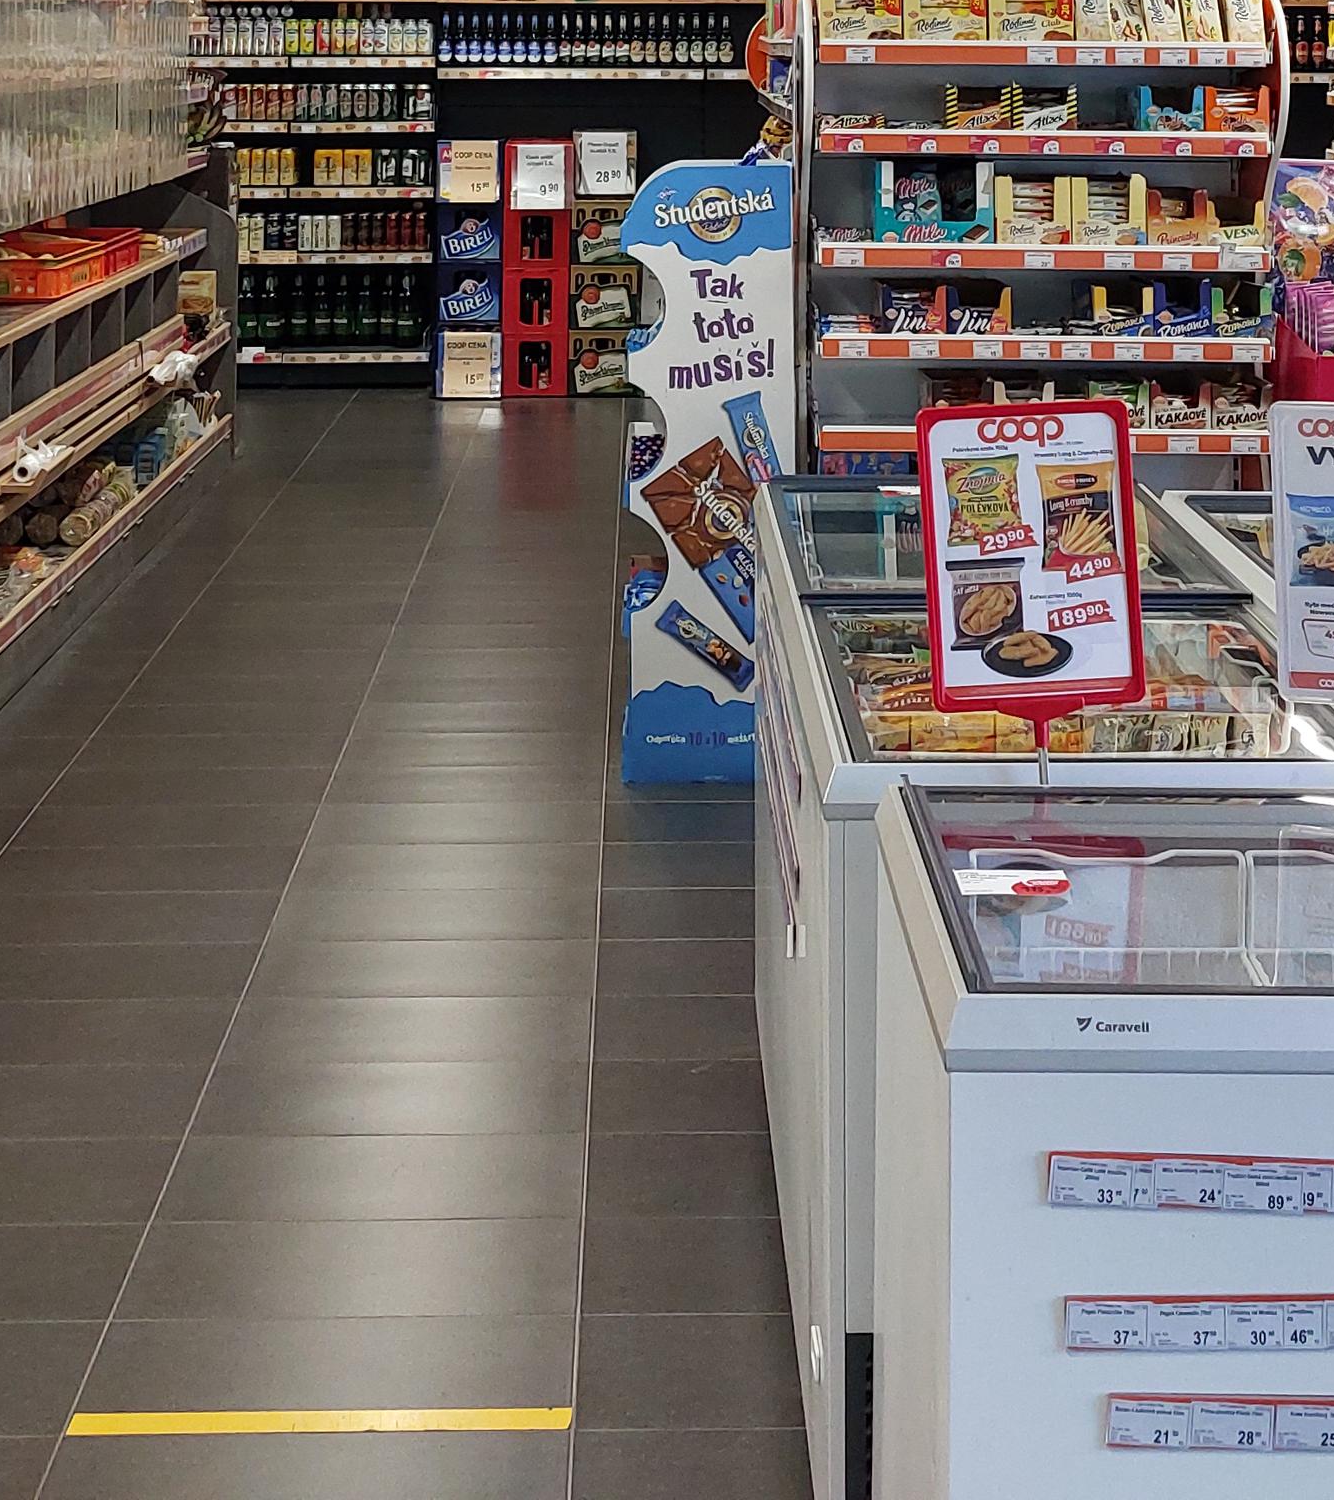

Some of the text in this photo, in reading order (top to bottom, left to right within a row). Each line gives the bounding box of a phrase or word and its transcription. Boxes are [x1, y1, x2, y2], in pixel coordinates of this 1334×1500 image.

[964, 112, 999, 129] Attack
[1028, 114, 1065, 129] Attack
[454, 151, 473, 159] COOP
[654, 187, 775, 228] Studentská
[1223, 228, 1259, 240] VESNA
[690, 268, 744, 301] Tak
[693, 311, 754, 344] toto
[669, 338, 776, 393] musíš!
[977, 416, 1064, 447] coop
[1095, 1019, 1150, 1034] Caravell
